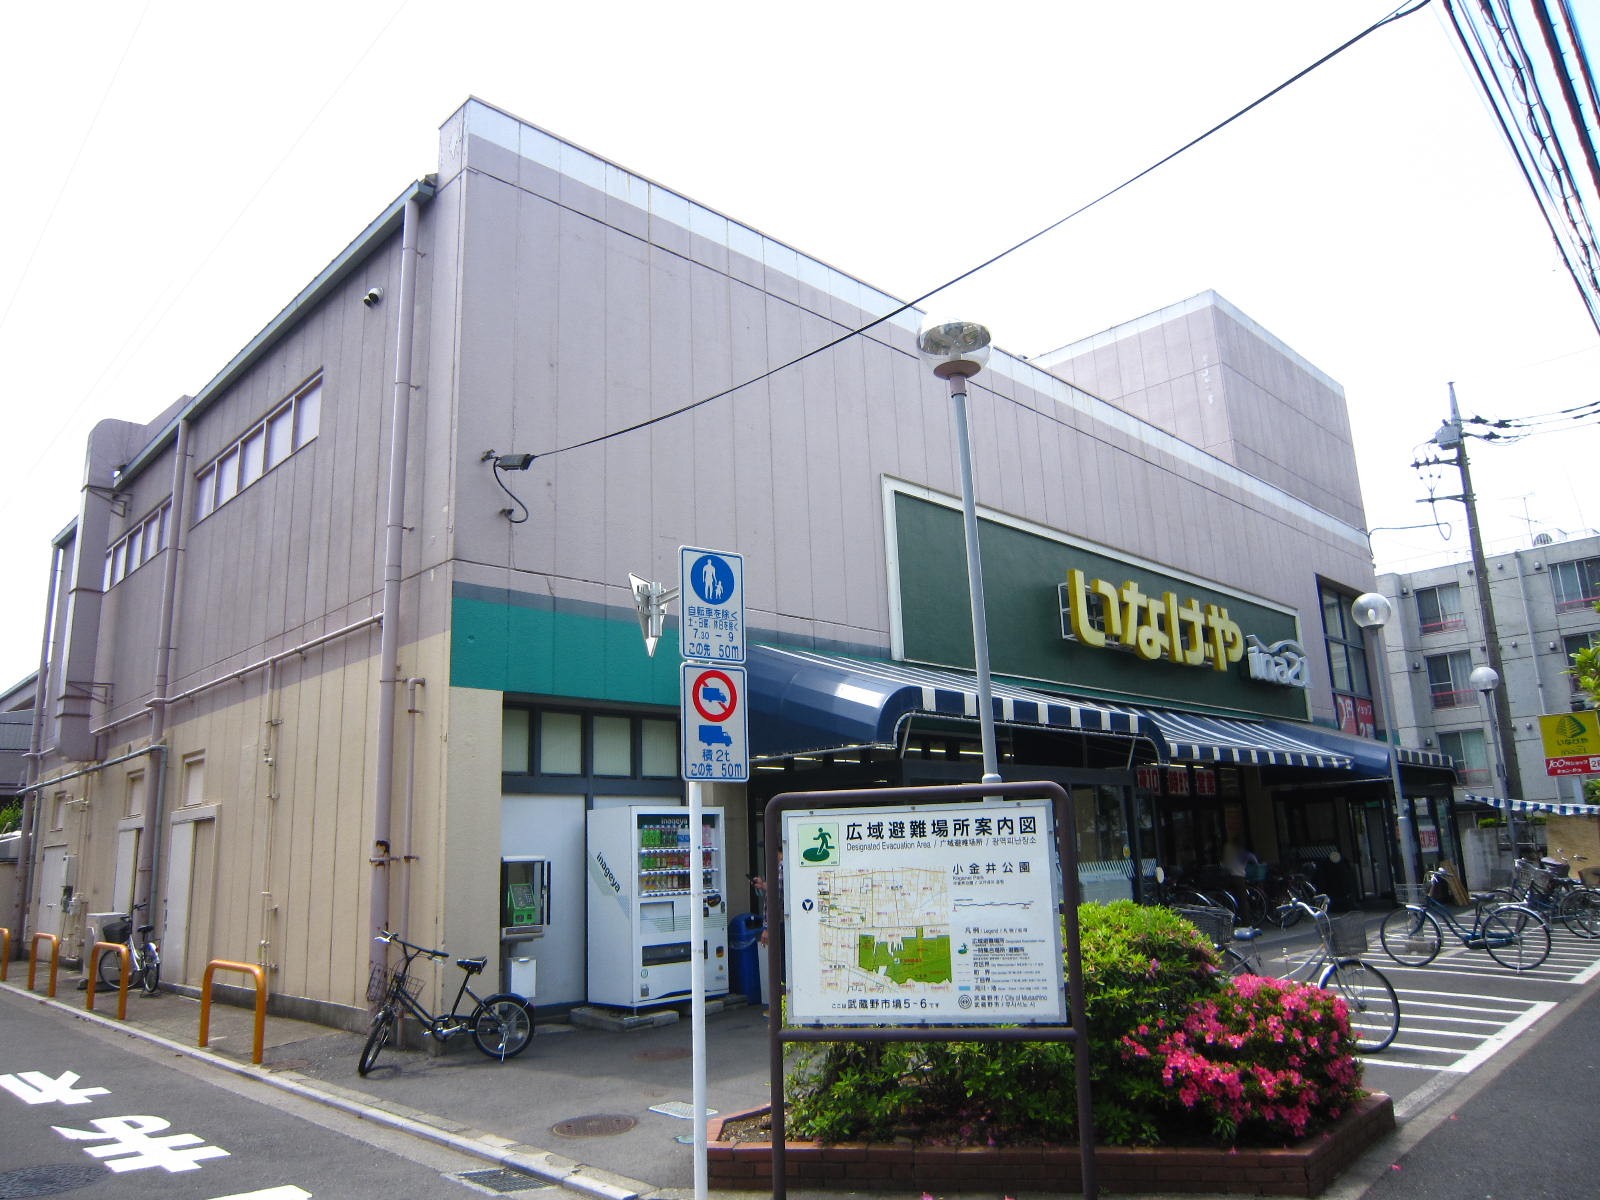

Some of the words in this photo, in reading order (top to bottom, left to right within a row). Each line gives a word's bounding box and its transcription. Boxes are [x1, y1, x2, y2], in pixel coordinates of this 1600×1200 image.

[688, 606, 738, 621] 自転車を除く
[1067, 568, 1244, 672] いなげや
[728, 632, 734, 642] 9
[689, 643, 711, 656] この先
[719, 644, 739, 659] 50m
[702, 749, 730, 762] 積2t
[691, 763, 712, 777] この先
[721, 763, 742, 777] 50m
[661, 817, 688, 826] inageya
[846, 816, 1037, 840] 広域避難場所案内図
[847, 842, 880, 852] Designated
[882, 841, 915, 851] Evacuation
[917, 840, 931, 850] Area
[596, 851, 622, 894] inageya
[952, 861, 1030, 875] 小金井公園
